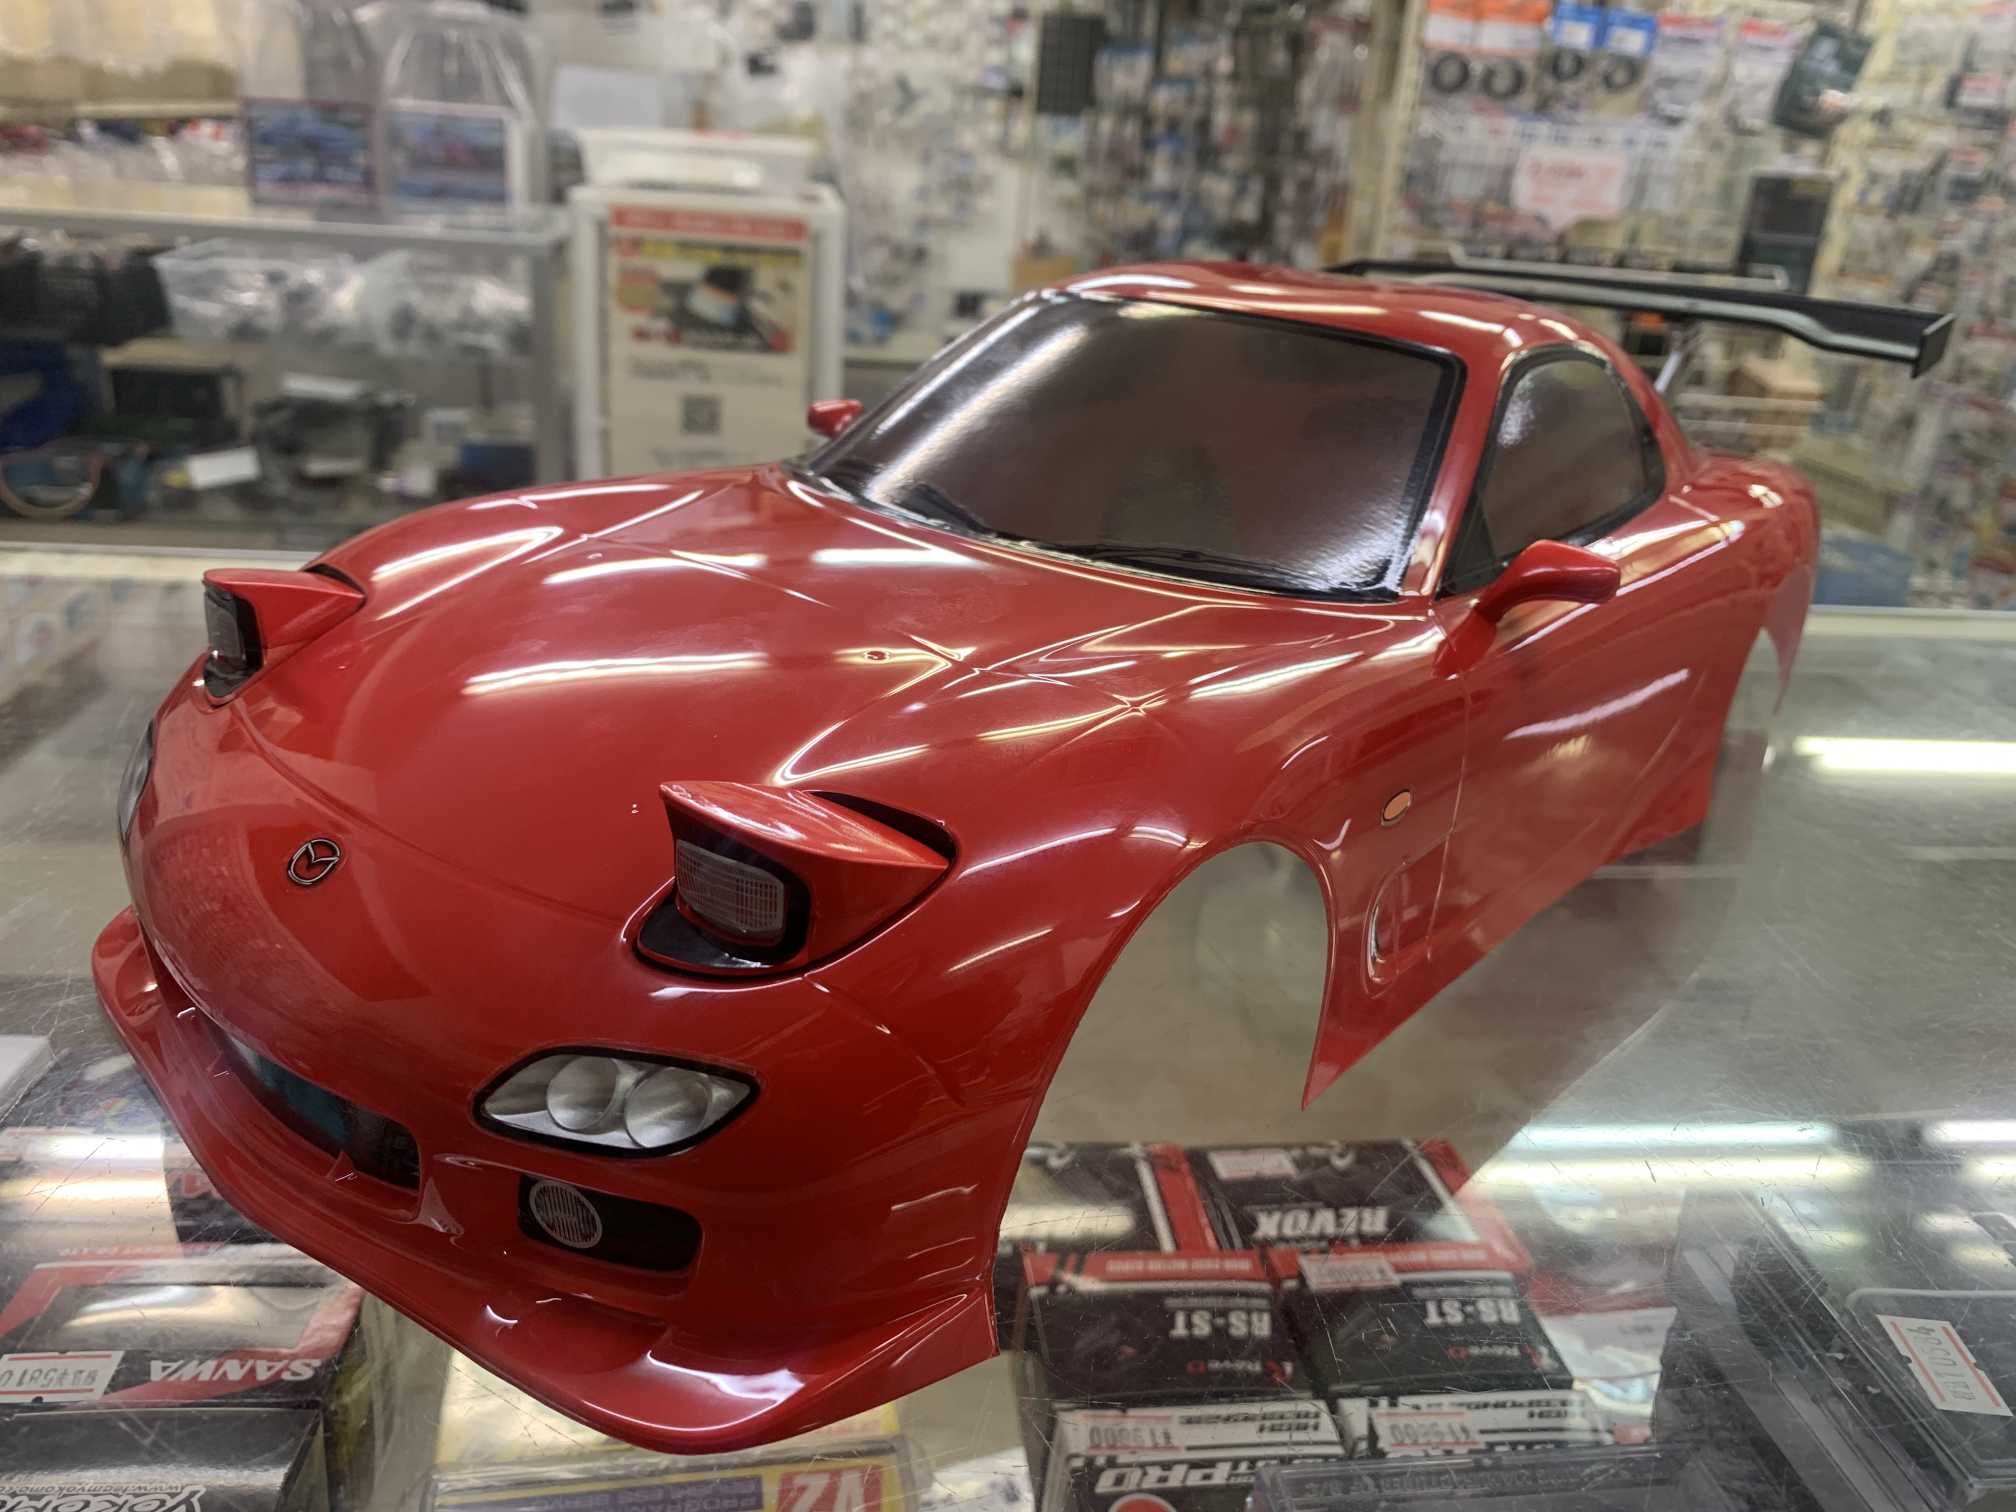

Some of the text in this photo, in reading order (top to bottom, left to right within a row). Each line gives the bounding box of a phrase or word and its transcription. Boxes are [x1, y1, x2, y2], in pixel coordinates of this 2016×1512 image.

[1255, 1205, 1391, 1239] REVOX
[1169, 1309, 1273, 1339] RS-ST
[1423, 1300, 1521, 1327] RS-ST
[150, 1359, 321, 1382] SANWA
